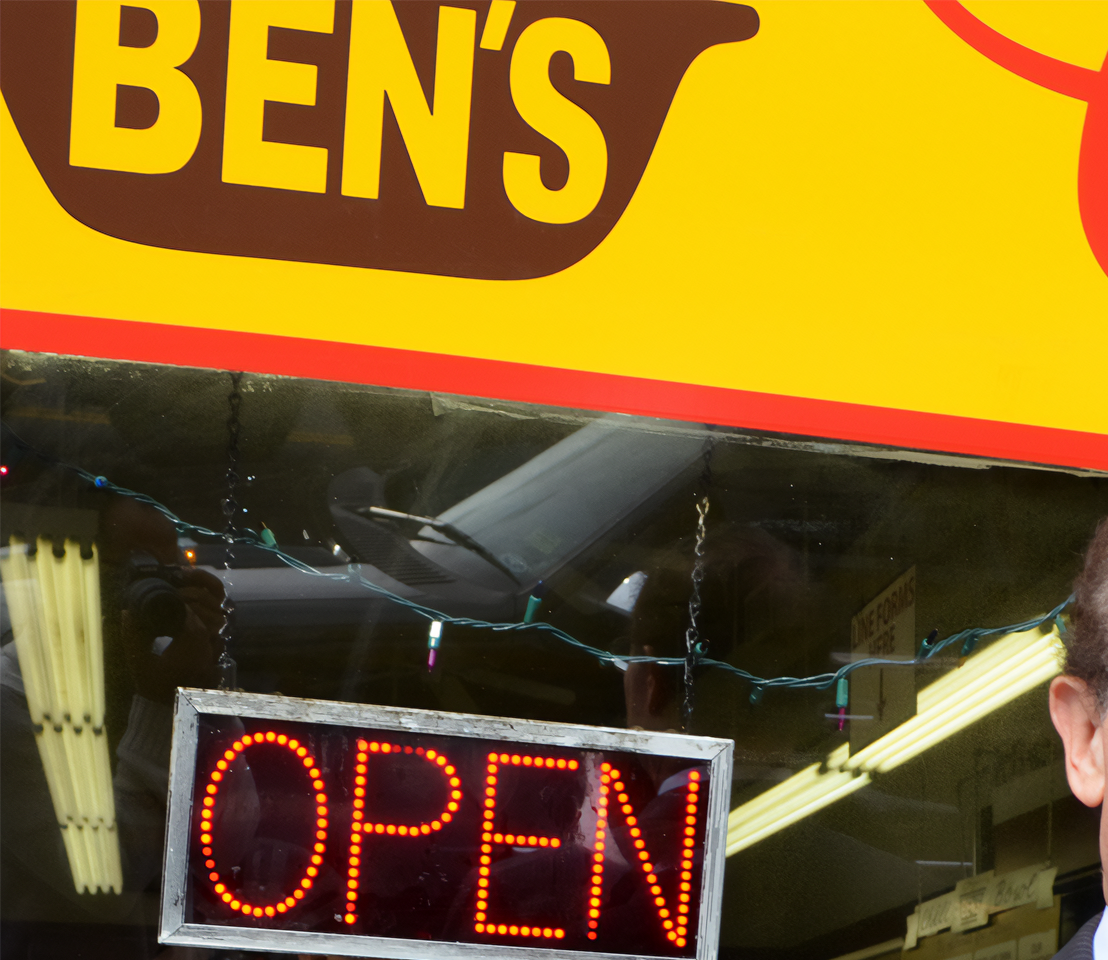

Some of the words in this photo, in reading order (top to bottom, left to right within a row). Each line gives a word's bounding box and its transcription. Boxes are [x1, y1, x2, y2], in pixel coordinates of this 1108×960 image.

[69, 0, 611, 224] BEN'S
[869, 624, 896, 655] HERE
[876, 576, 915, 630] FORMS
[201, 731, 700, 947] OPEN
